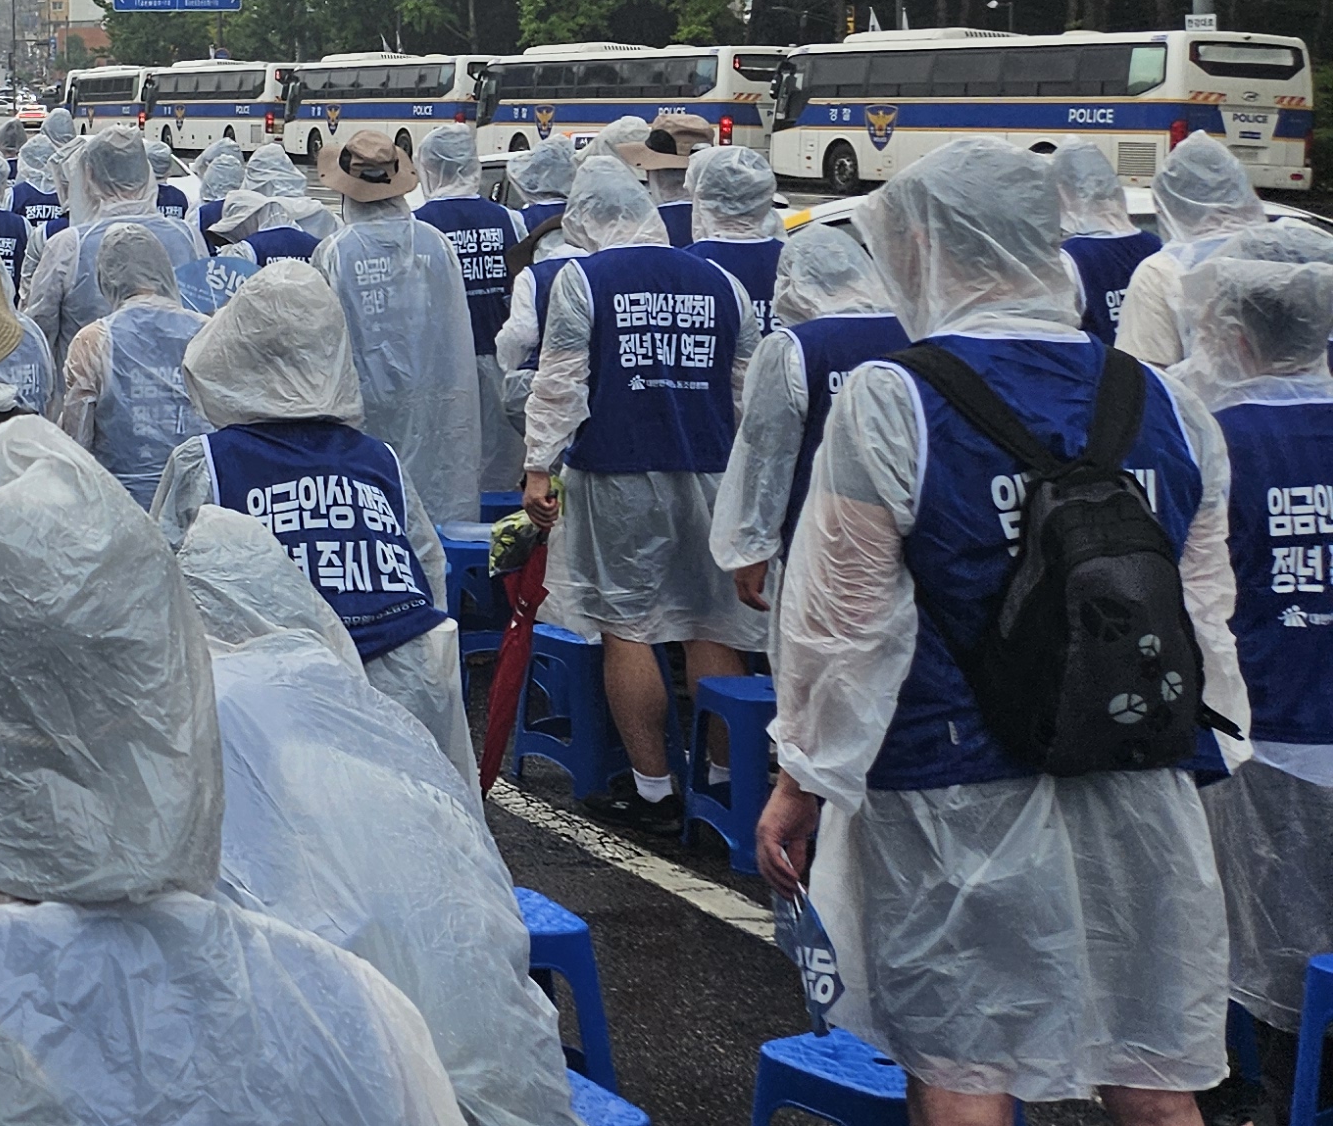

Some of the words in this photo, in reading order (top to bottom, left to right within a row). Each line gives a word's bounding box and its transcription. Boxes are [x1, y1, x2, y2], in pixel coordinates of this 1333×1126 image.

[235, 105, 251, 115] POLICE
[412, 105, 434, 116] POLICE
[829, 108, 851, 122] 경찰
[1068, 108, 1114, 124] POLICE
[1233, 113, 1269, 124] POLICE
[479, 228, 504, 252] 쟁취!
[613, 292, 675, 329] 임금인상
[675, 293, 716, 330] 쟁취!
[618, 332, 653, 368] 정년
[680, 333, 717, 368] 연금!
[246, 474, 353, 534] 임금인상
[317, 540, 370, 594] 즉시
[1271, 546, 1324, 594] 정년
